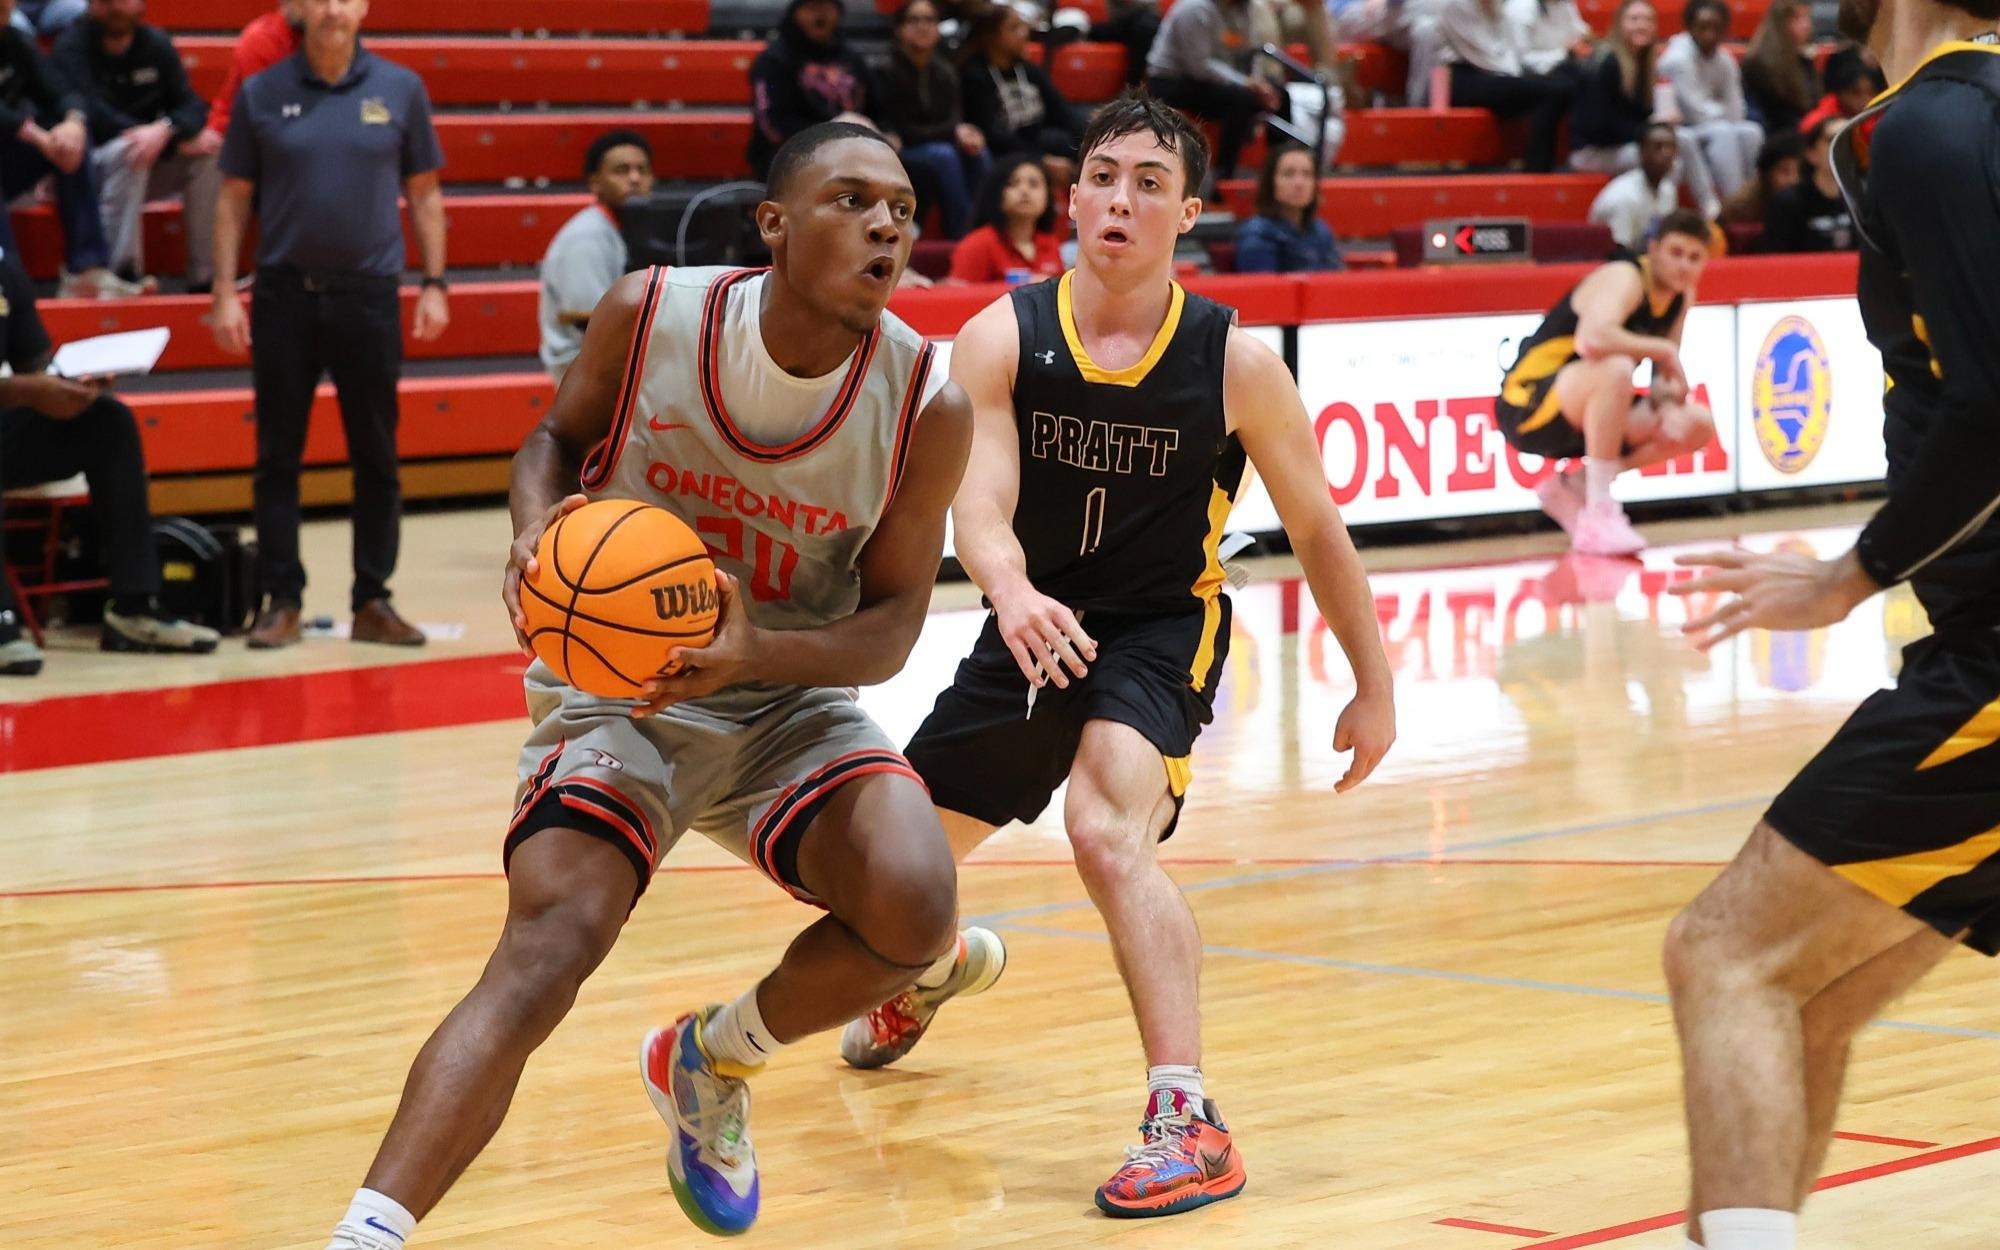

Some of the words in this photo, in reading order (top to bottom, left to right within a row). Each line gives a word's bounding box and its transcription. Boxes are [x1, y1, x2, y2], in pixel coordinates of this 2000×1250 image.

[1032, 411, 1179, 476] PRATT
[646, 462, 848, 536] ONEONTA
[1080, 487, 1106, 556] 1
[696, 515, 799, 602] 20
